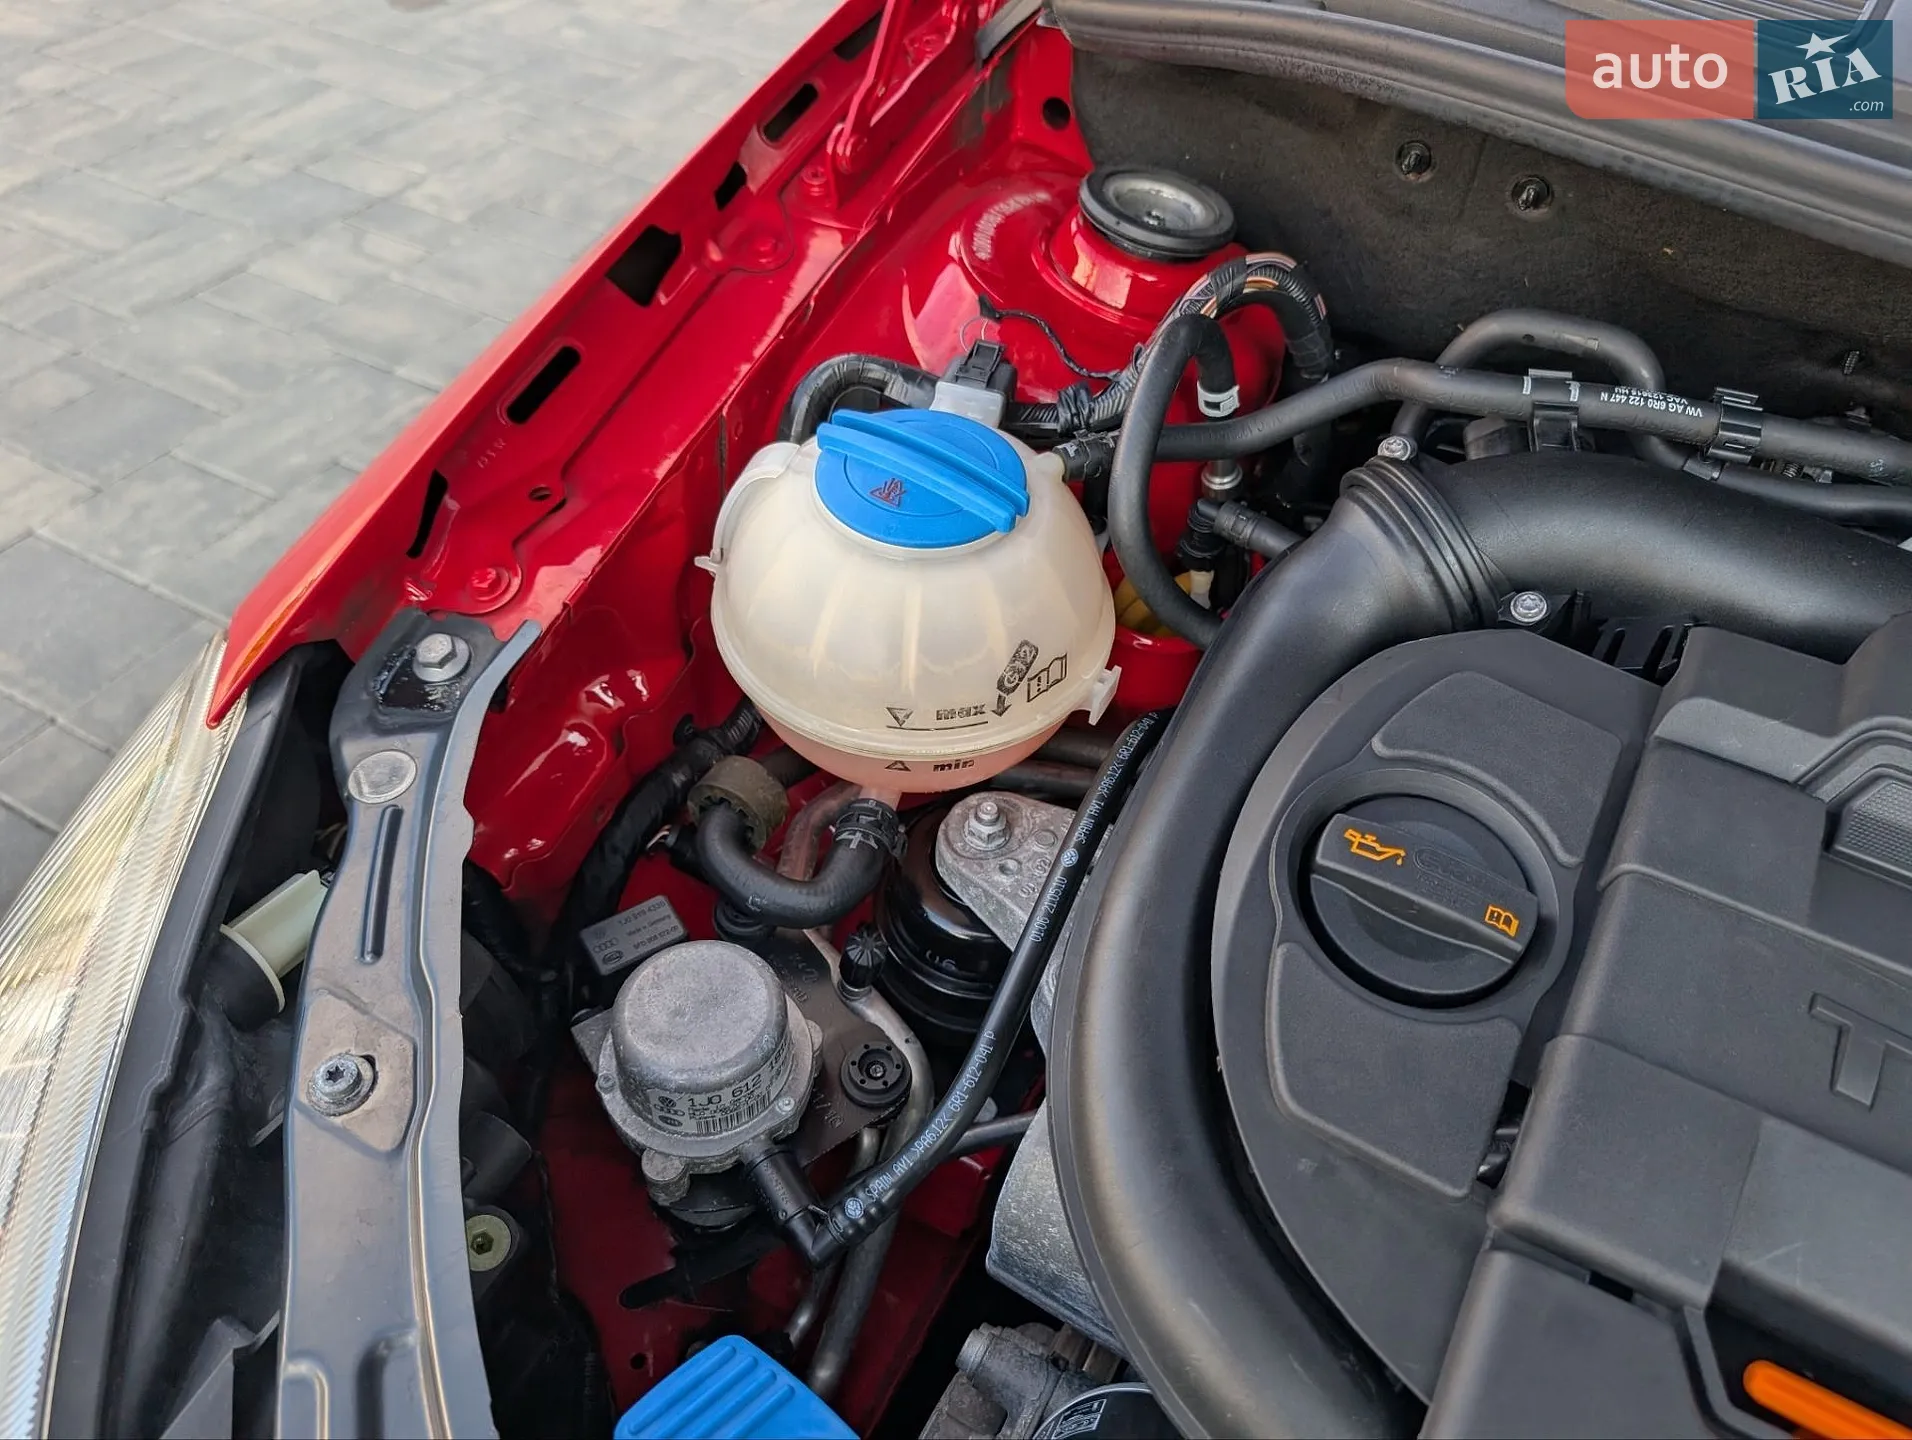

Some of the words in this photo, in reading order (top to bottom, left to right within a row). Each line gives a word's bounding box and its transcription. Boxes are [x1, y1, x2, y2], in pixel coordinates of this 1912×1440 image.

[1610, 393, 1628, 404] 447
[1628, 395, 1645, 406] 122
[1668, 402, 1685, 413] AG
[1685, 405, 1703, 417] VW
[936, 703, 987, 721] max
[1075, 815, 1095, 844] SPAIN
[732, 1074, 761, 1098] 612
[864, 1172, 893, 1202] SPAIN
[950, 1043, 994, 1113] 6R1-612-041
[983, 1030, 996, 1041] P
